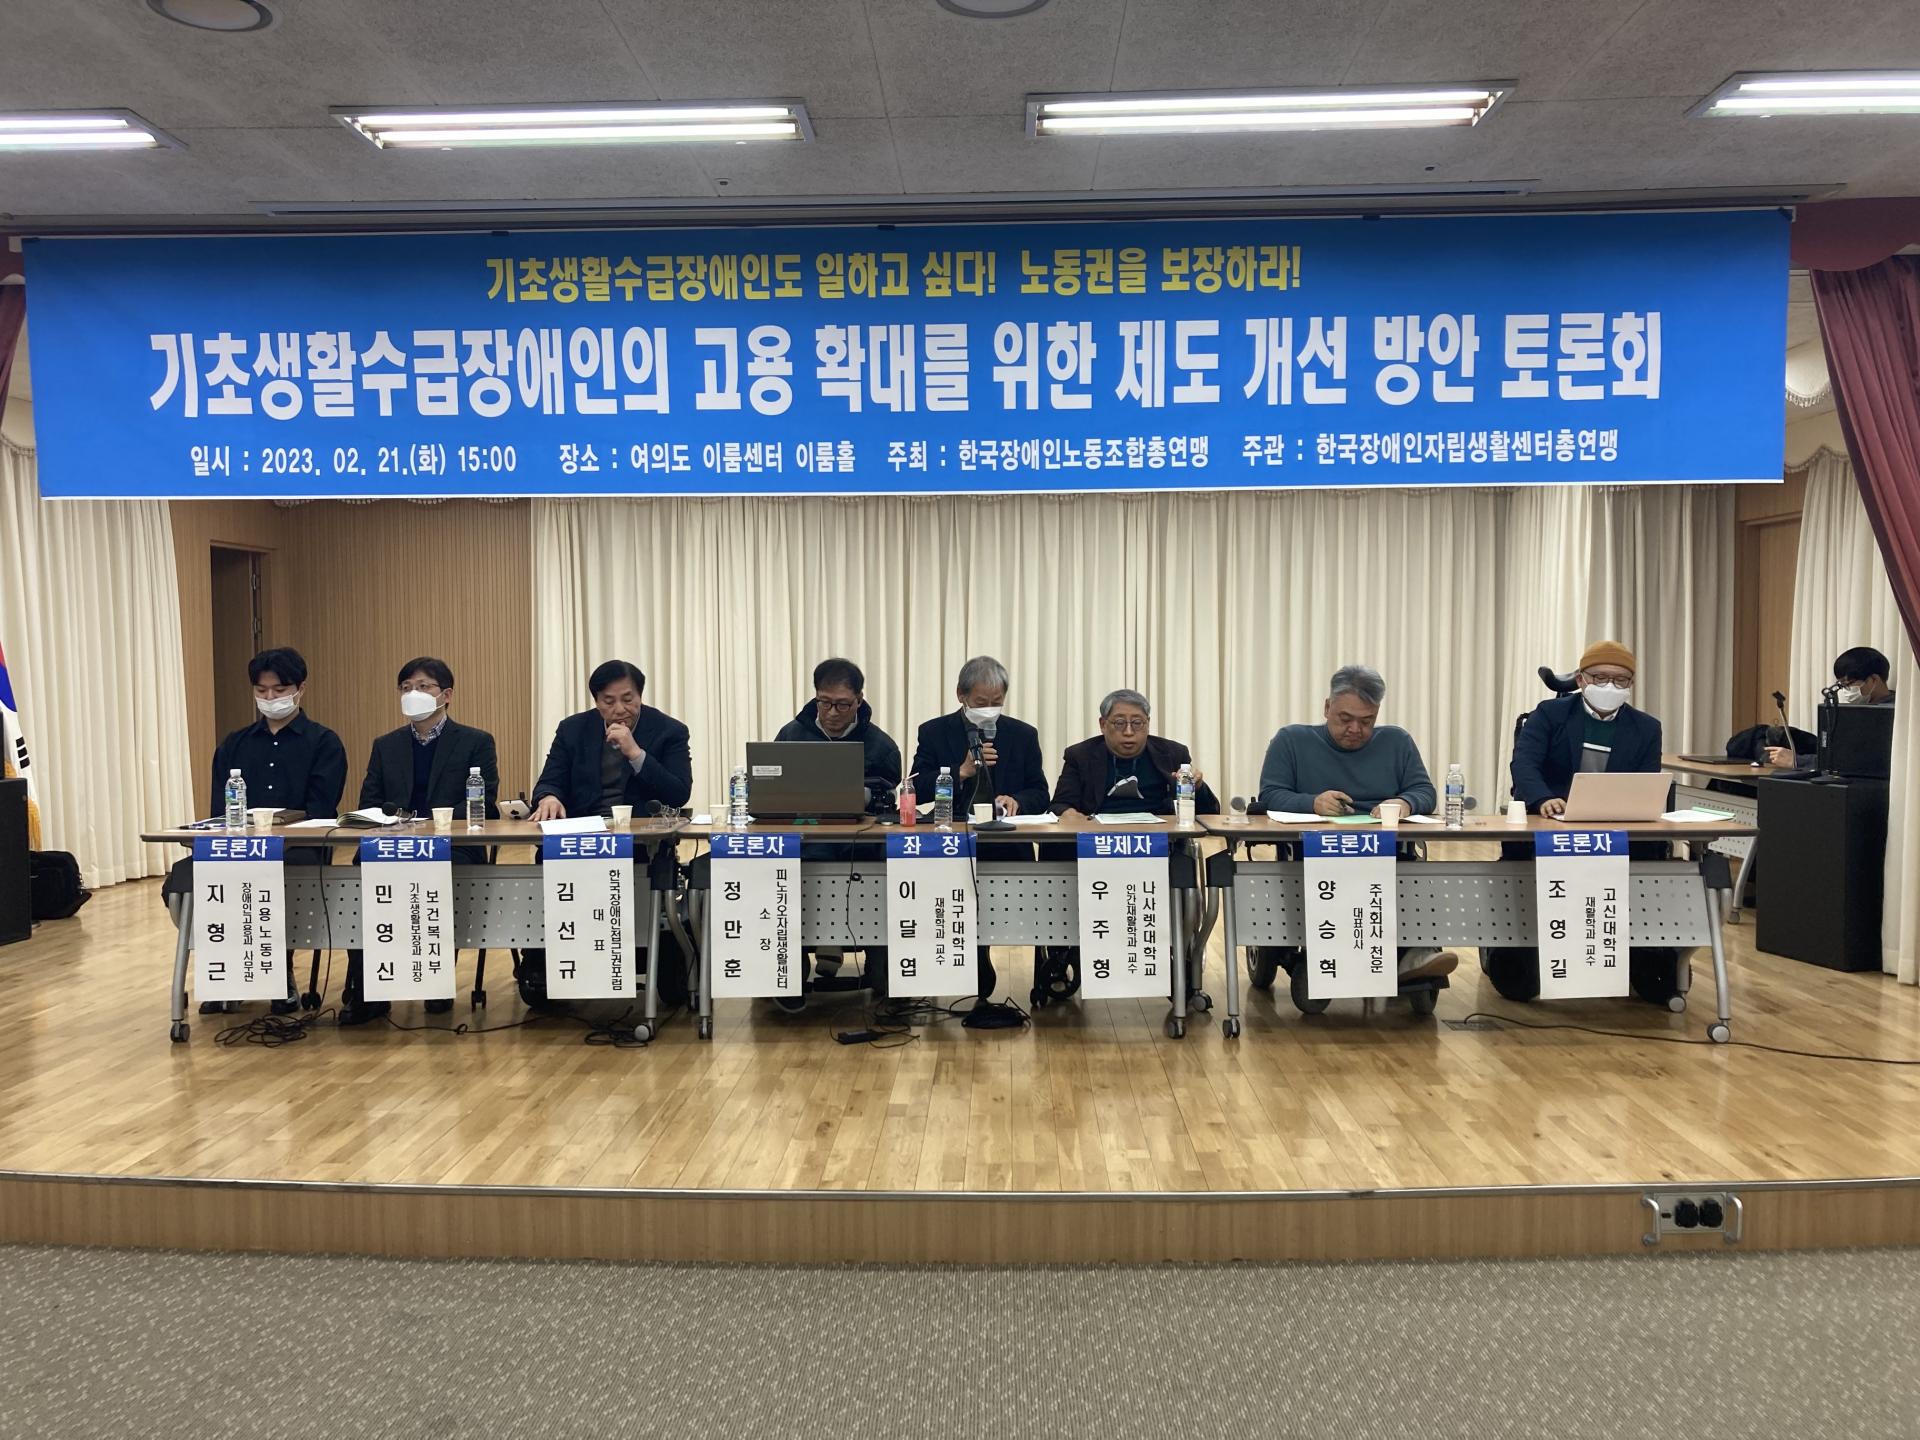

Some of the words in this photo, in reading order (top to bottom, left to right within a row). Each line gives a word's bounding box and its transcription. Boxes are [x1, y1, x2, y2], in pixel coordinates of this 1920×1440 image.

[487, 255, 802, 303] 기초생활수급장애인도
[816, 253, 909, 298] 일하고
[922, 252, 995, 297] 싶다!
[1021, 248, 1146, 295] 노동권을
[1162, 246, 1300, 293] 보장하라!
[150, 327, 669, 420] 기초생활수급장애인의
[695, 325, 792, 415] 고용
[816, 324, 969, 412] 확대를
[993, 321, 1096, 410] 위한
[1115, 320, 1220, 407] 제도
[1244, 317, 1346, 405] 개선
[1374, 314, 1479, 405] 방안
[1502, 312, 1661, 400] 토론회
[191, 446, 229, 476] 일시
[262, 448, 320, 476] 2023.
[334, 448, 366, 475] 02.
[379, 444, 445, 475] 21.(화)
[458, 446, 516, 472] 15:00
[560, 444, 599, 474] 장소
[631, 443, 691, 473] 여의도
[703, 442, 782, 473] 이룸센터
[796, 441, 855, 472] 이룸홀
[888, 441, 927, 472] 주최
[959, 436, 1208, 470] 한국장애인노동조합총연맹
[1243, 435, 1284, 466] 주관
[1317, 429, 1617, 464] 한국장애인자립생활센터총연맹
[210, 839, 267, 858] 토론자
[377, 839, 434, 858] 토론자
[560, 836, 617, 855] 토론자
[728, 836, 784, 855] 토론자
[1095, 835, 1152, 854] 발제자
[1321, 834, 1379, 853] 토론자
[1553, 833, 1612, 852] 토론자
[410, 883, 421, 955] 기초생활보장과
[952, 889, 965, 966] 대구대학교
[1370, 884, 1383, 938] 주식회사
[1603, 888, 1616, 967] 고신대학교
[259, 890, 272, 974] 고용노동부
[427, 891, 441, 974] 보건복지부
[609, 870, 622, 990] 한국장애인접근권포럼
[776, 869, 788, 989] 피노키오자립생활센터
[1143, 881, 1156, 976] 나사렛대학교
[1353, 908, 1363, 950] 대표이사
[243, 951, 253, 982] 사무관
[412, 961, 422, 982] 과장
[935, 945, 945, 965] 교수
[1127, 953, 1137, 974] 교수
[1370, 946, 1383, 973] 천운
[1585, 945, 1595, 966] 교수
